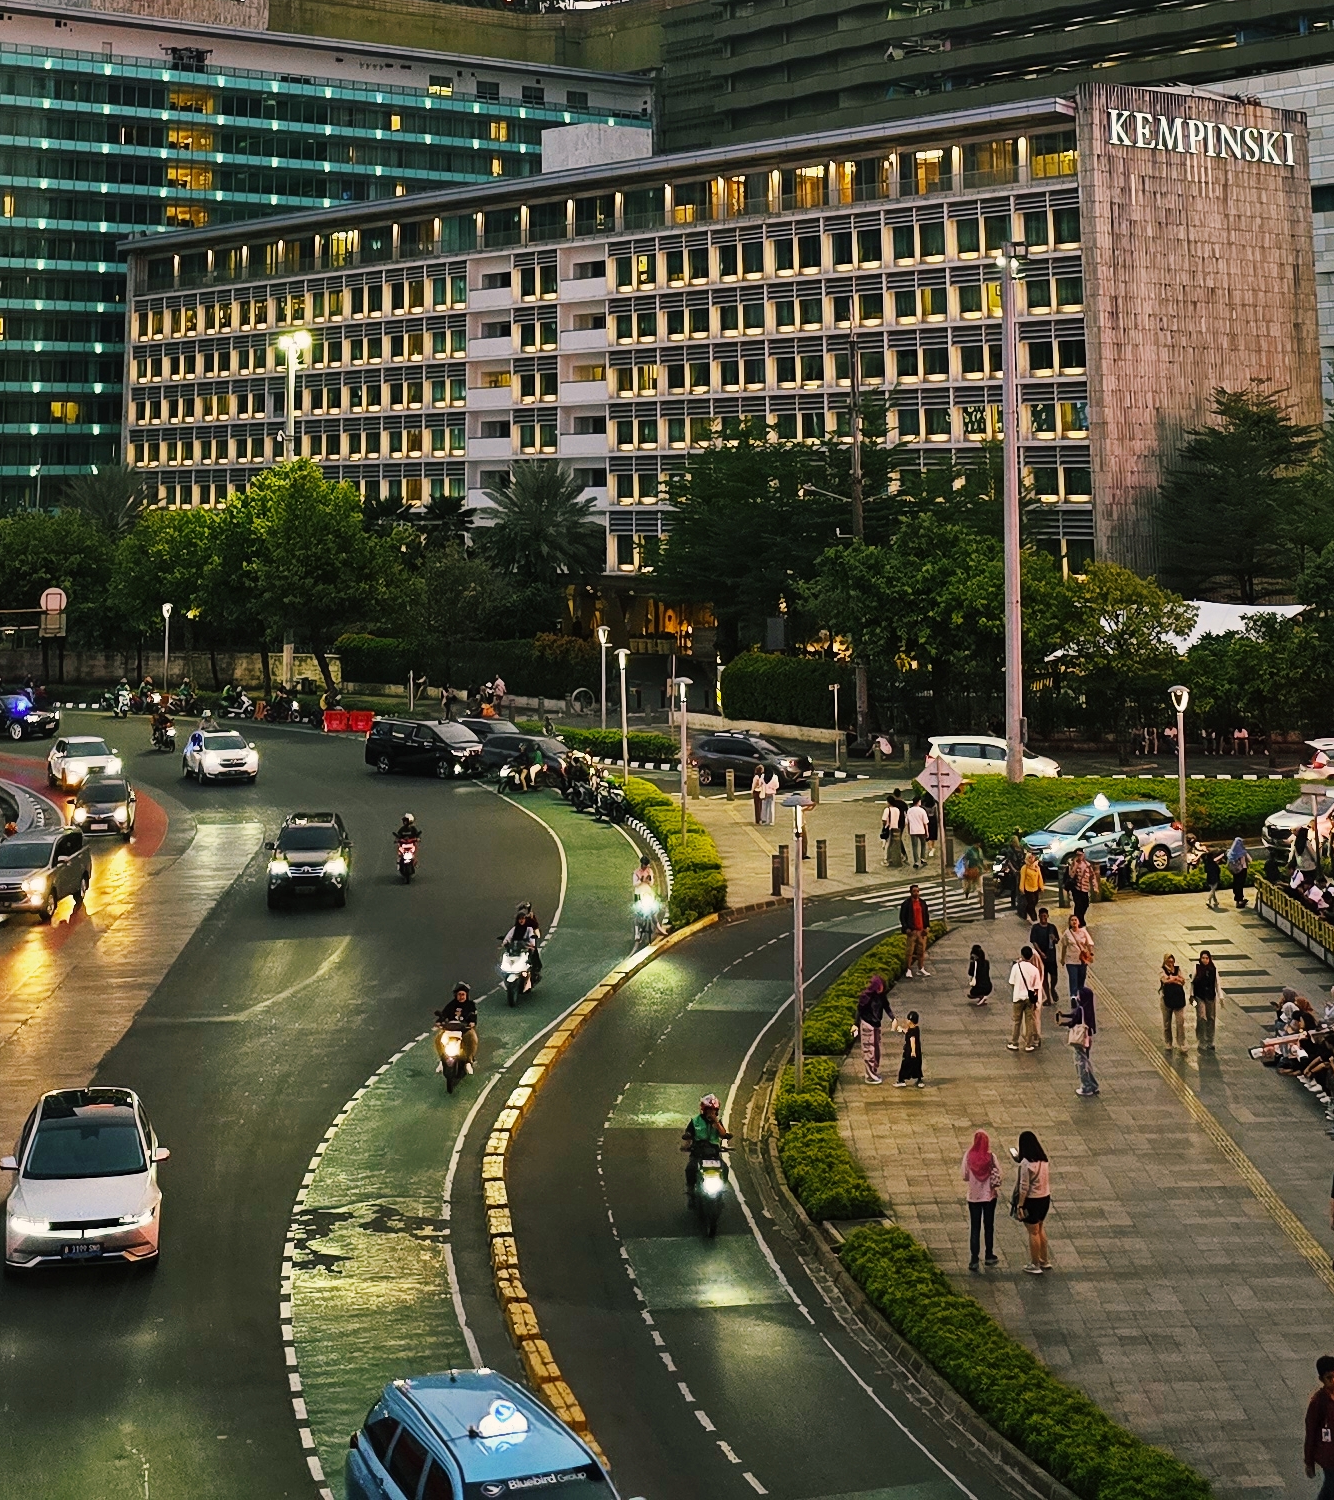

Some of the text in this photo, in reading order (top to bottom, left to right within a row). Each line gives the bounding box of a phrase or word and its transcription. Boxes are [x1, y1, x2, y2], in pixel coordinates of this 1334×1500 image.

[1108, 108, 1296, 166] KEMPINSKI
[508, 1471, 587, 1490] Bluebird Group
